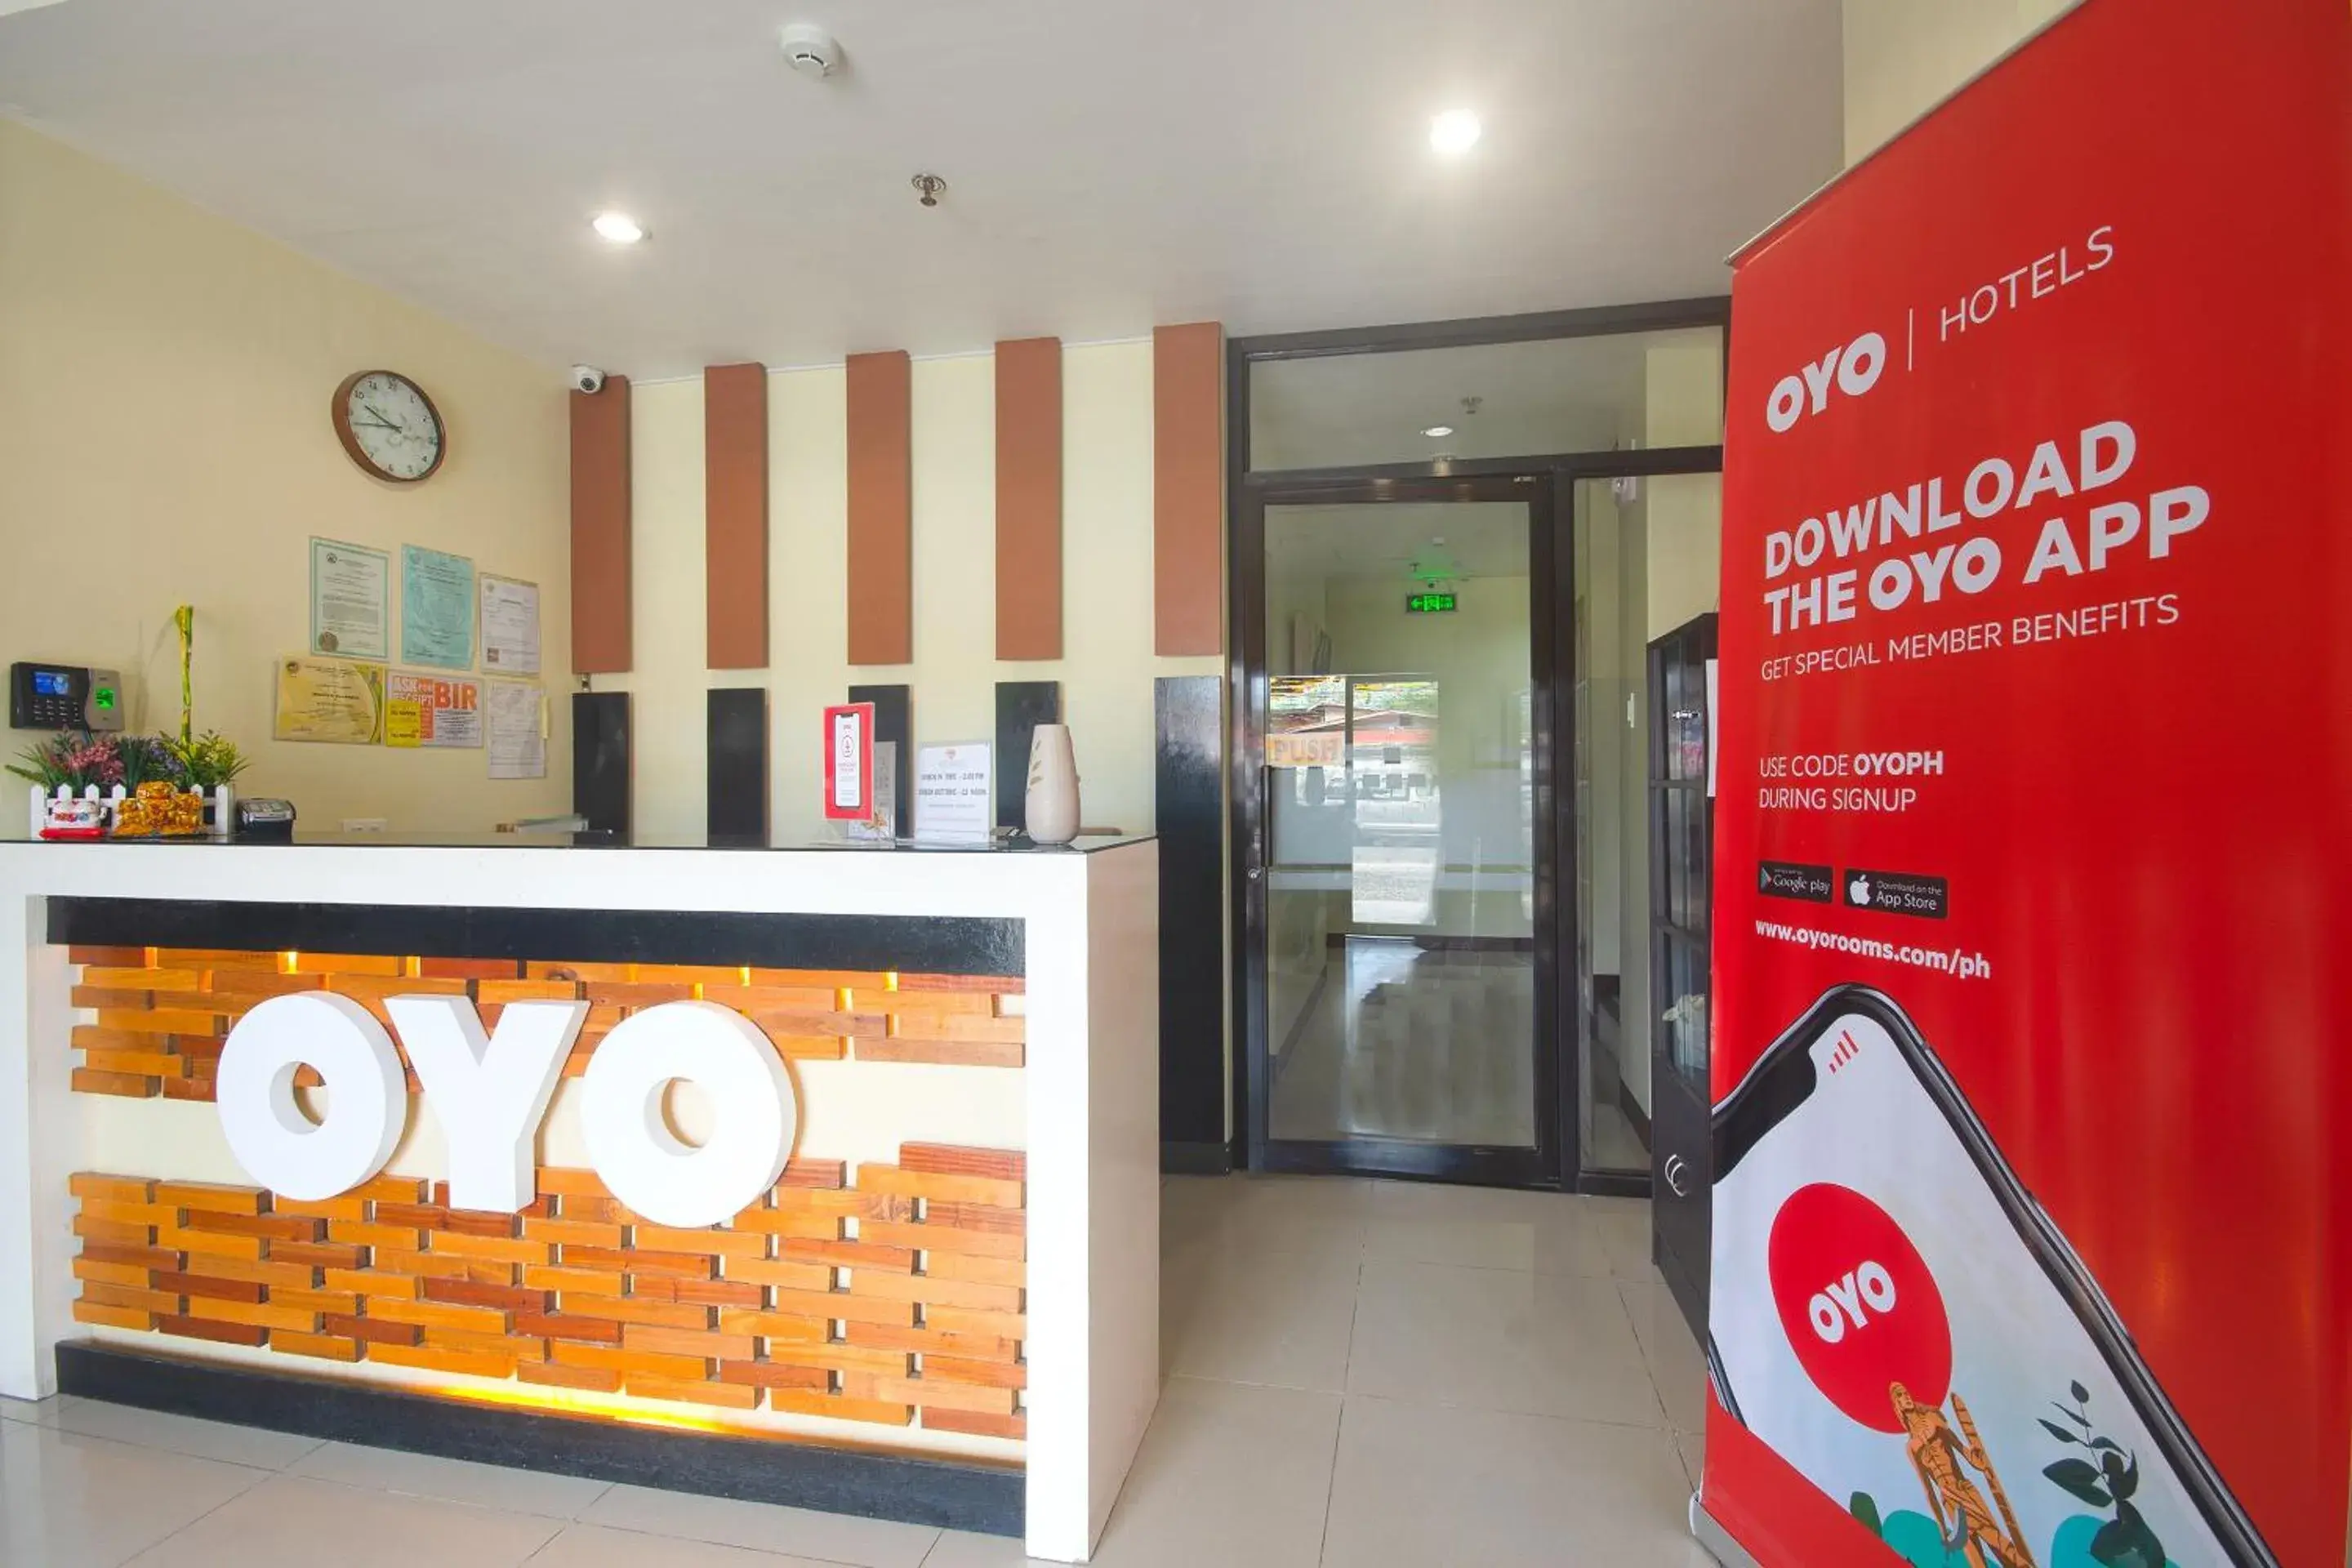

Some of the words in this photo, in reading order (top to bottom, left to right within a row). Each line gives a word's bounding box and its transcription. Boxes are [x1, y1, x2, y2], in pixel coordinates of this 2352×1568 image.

[1766, 332, 1886, 433] OYO
[1940, 225, 2114, 341] HOTELS
[1765, 421, 2136, 579] DOWNLOAD
[1763, 568, 1856, 635] THE
[1869, 537, 2002, 611] OYO
[2023, 486, 2210, 585] APP
[1762, 656, 1791, 680] GET
[1794, 641, 1881, 675] SPECIAL
[1888, 622, 2002, 662] MEMBER
[2011, 594, 2180, 645] BENEFITS
[434, 682, 478, 710] BIR
[1274, 738, 1339, 761] PUSH
[1760, 756, 1787, 777] USE
[1791, 754, 1851, 777] CODE
[1853, 751, 1944, 776] OYOPH
[1759, 788, 1826, 809] DURING
[1832, 787, 1917, 812] SIGNUP
[1773, 874, 1807, 893] Google
[1810, 878, 1830, 894] play
[1876, 880, 1915, 893] Download
[1916, 885, 1927, 893] on
[1927, 884, 1942, 896] the
[1876, 890, 1901, 907] App
[1904, 893, 1937, 910] Store
[1755, 920, 1991, 979] www.oyorooms.com/ph
[216, 990, 797, 1228] OYO
[1809, 1260, 1895, 1343] OYO
